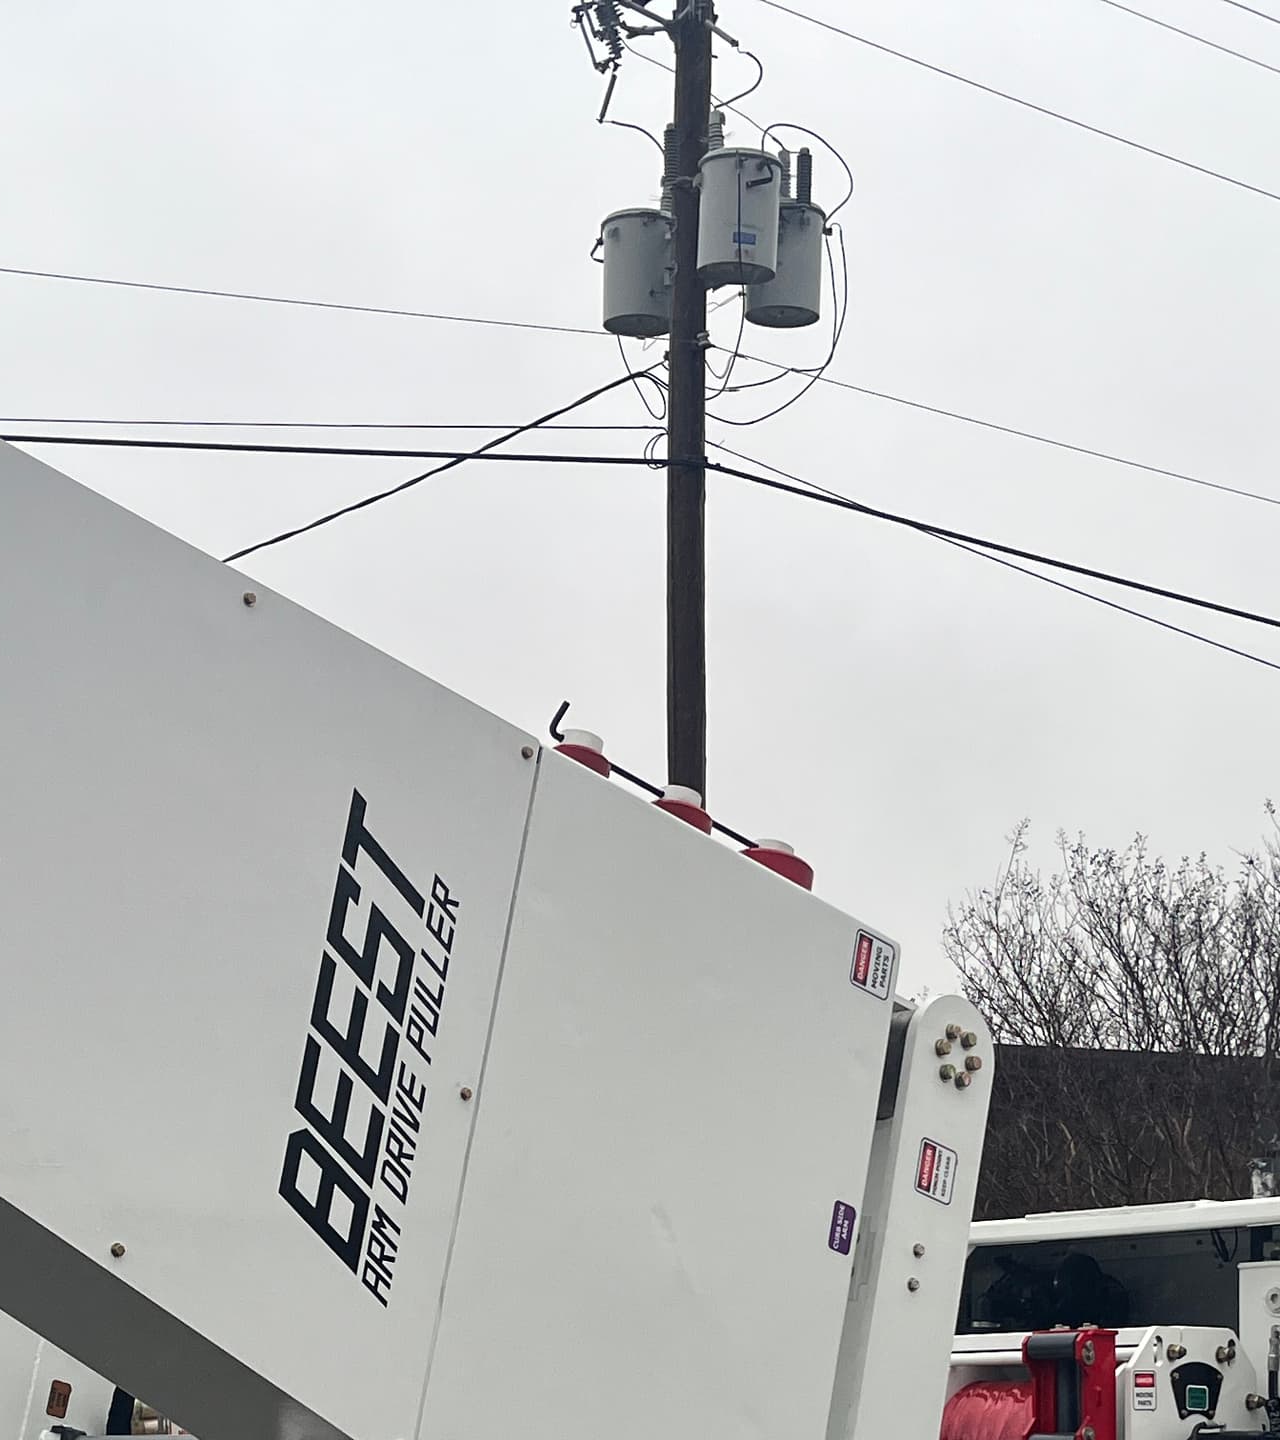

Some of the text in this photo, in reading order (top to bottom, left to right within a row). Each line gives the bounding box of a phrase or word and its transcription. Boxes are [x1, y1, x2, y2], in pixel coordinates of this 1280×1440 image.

[857, 938, 869, 981] DANGER
[871, 946, 883, 989] MOVING
[879, 954, 890, 988] PARTS
[279, 787, 426, 1275] BEEST
[362, 873, 460, 1308] ARM DRIVE PULLER
[921, 1148, 933, 1187] DANGER
[832, 1204, 846, 1249] CURB SIDE
[841, 1220, 849, 1240] ARM
